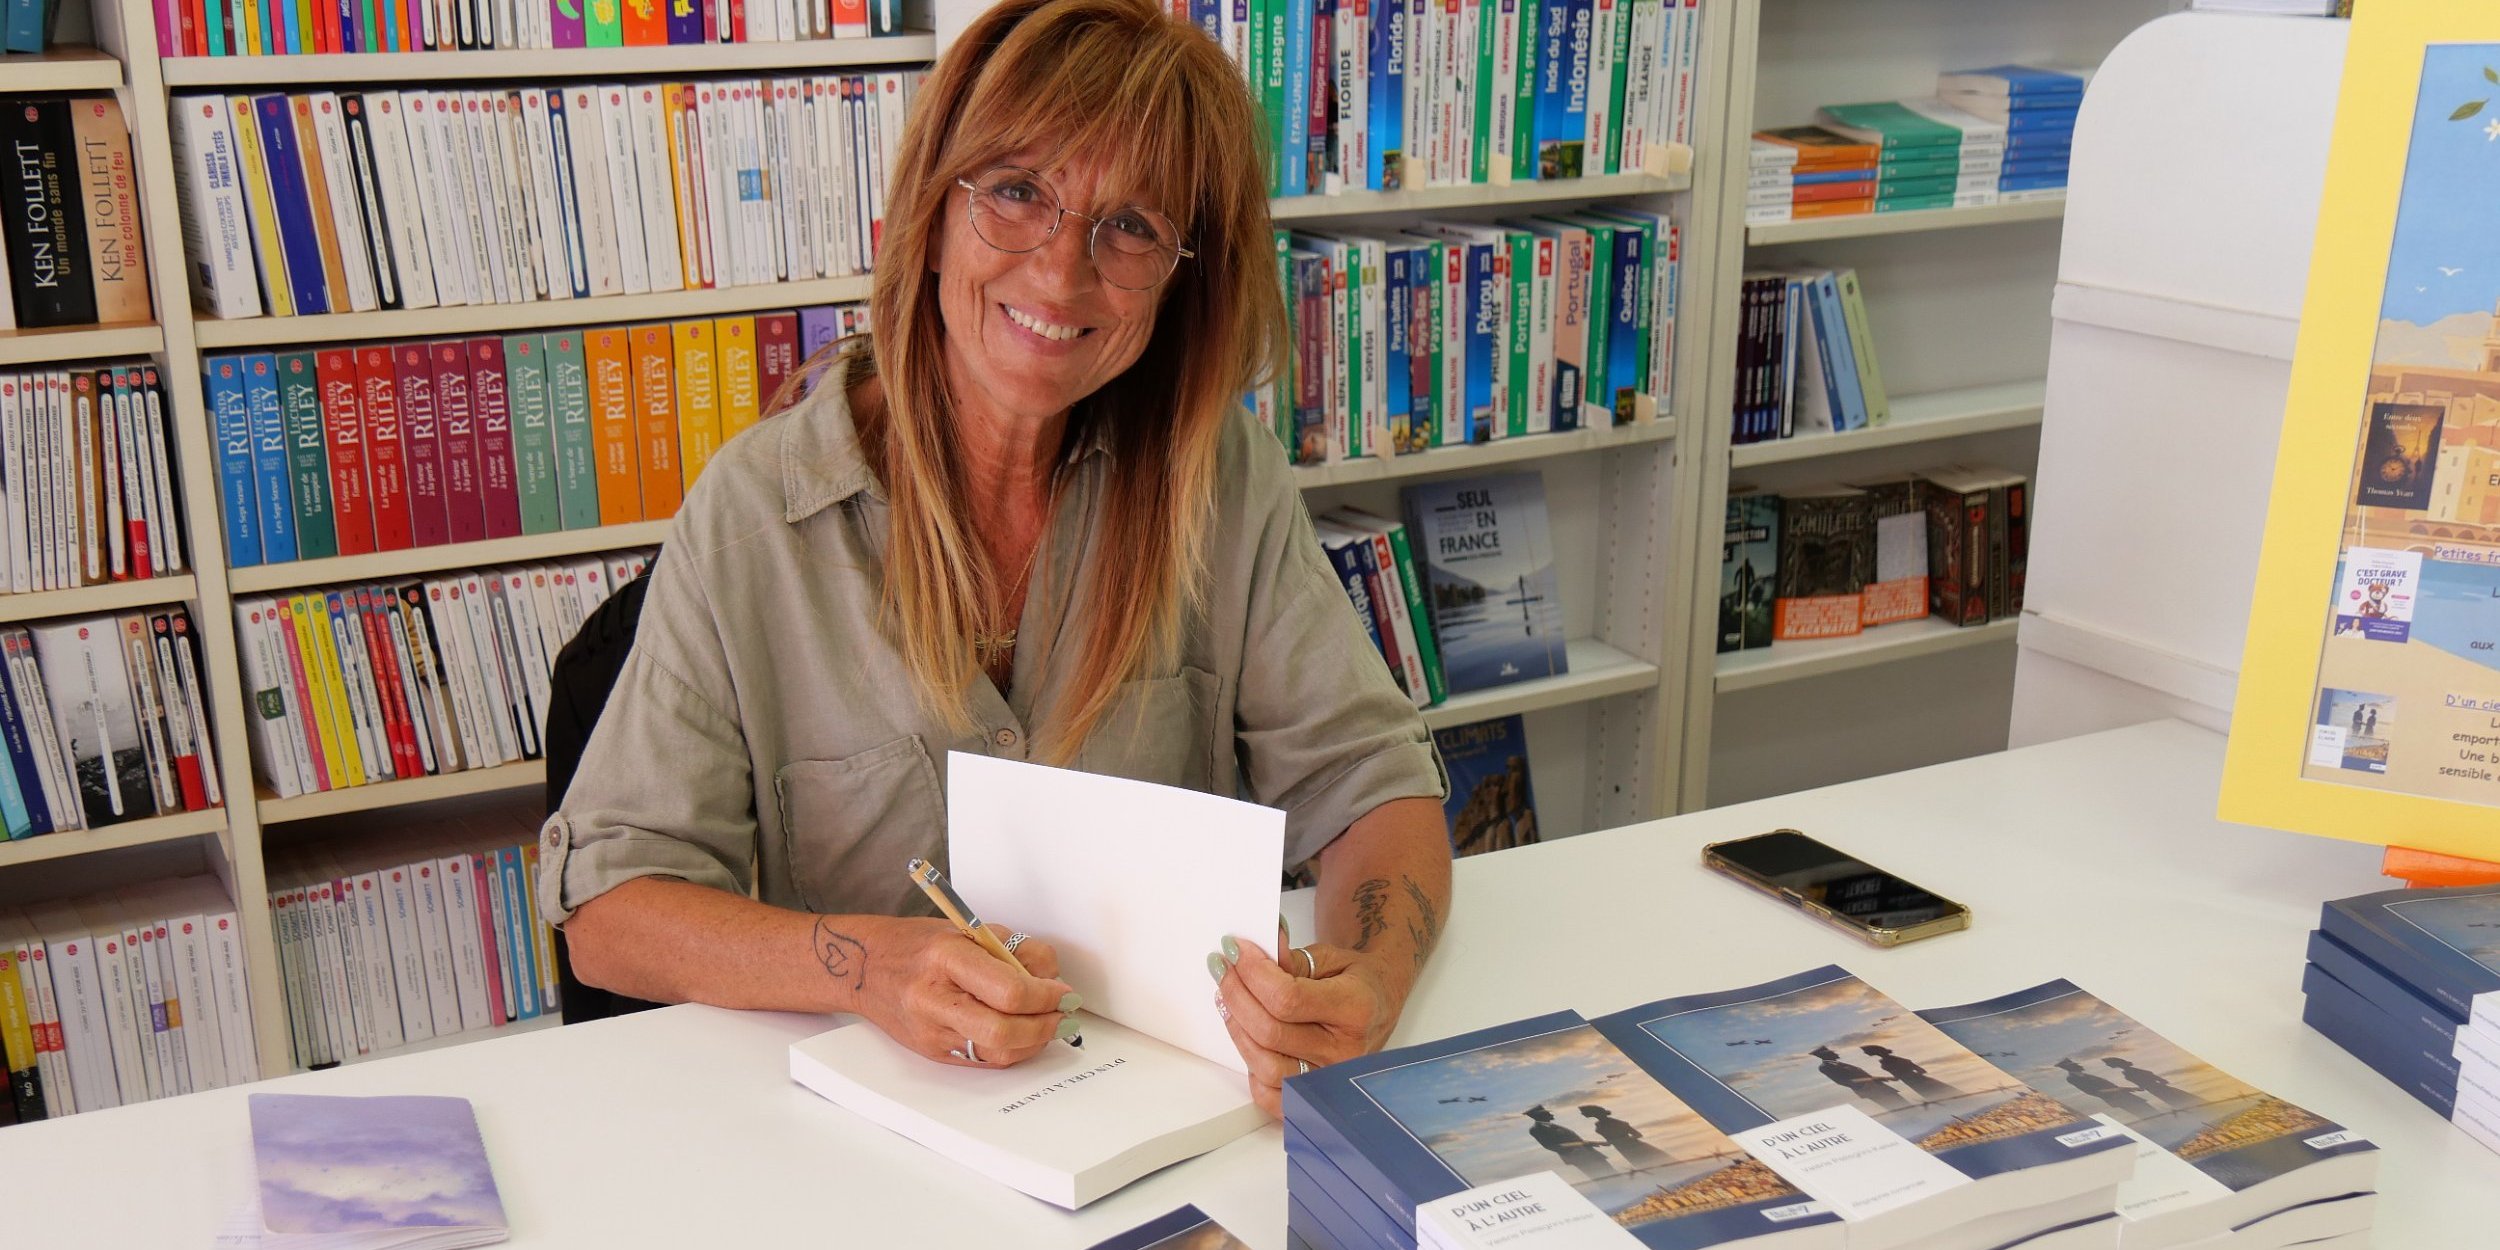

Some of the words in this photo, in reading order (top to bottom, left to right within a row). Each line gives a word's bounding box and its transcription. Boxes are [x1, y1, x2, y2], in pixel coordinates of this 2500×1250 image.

[1255, 11, 1264, 28] Est
[1523, 3, 1537, 69] grecques
[1549, 6, 1562, 36] Sud
[1614, 1, 1628, 63] Irlande
[1269, 14, 1284, 87] Espagne
[1388, 12, 1404, 75] Floride
[1547, 39, 1560, 58] du
[1567, 8, 1590, 113] Indonésie
[1340, 49, 1351, 119] FLORIDE
[1545, 61, 1557, 93] Inde
[1639, 45, 1652, 102] ISLANDE
[43, 152, 56, 168] fin
[112, 152, 124, 171] feu
[213, 131, 226, 154] ESTÉS
[16, 140, 49, 233] FOLLETT
[46, 174, 62, 204] sans
[85, 136, 115, 228] FOLLETT
[114, 175, 127, 189] de
[205, 152, 220, 189] CLARISSA
[215, 156, 232, 187] PINKOLA
[51, 210, 67, 252] monde
[117, 194, 133, 240] colonne
[33, 243, 58, 287] KEN
[57, 258, 70, 275] Un
[100, 239, 124, 281] KEN
[122, 245, 137, 267] Une
[1566, 240, 1584, 326] Portugal
[1620, 264, 1634, 322] Québec
[1415, 290, 1428, 357] Pays-Bas
[1430, 280, 1441, 353] Pays-Bas
[1476, 279, 1493, 334] Pérou
[1515, 282, 1530, 353] Portugal
[1337, 313, 1346, 365] BHOUTAN
[1363, 330, 1374, 382] NORVÈGE
[1391, 321, 1404, 351] Pays
[1491, 301, 1502, 384] PHILIPPINES
[515, 366, 528, 414] LUCINDA
[557, 363, 569, 411] LUCINDA
[597, 359, 609, 407] LUCINDA
[605, 358, 627, 420] RILEY
[641, 355, 653, 402] LUCINDA
[650, 355, 670, 415] RILEY
[685, 350, 696, 396] LUCINDA
[693, 349, 712, 409] RILEY
[726, 348, 737, 394] LUCINDA
[734, 347, 753, 408] RILEY
[250, 388, 265, 437] LUCINDA
[287, 384, 301, 434] LUCINDA
[327, 381, 341, 431] LUCINDA
[336, 380, 359, 444] RILEY
[365, 378, 379, 427] LUCINDA
[375, 376, 397, 440] RILEY
[403, 376, 417, 426] LUCINDA
[413, 374, 435, 439] RILEY
[440, 373, 453, 422] LUCINDA
[449, 371, 471, 435] RILEY
[476, 369, 489, 418] LUCINDA
[485, 368, 507, 432] RILEY
[524, 365, 545, 428] RILEY
[565, 361, 585, 424] RILEY
[217, 391, 230, 441] LUCINDA
[227, 389, 250, 455] RILEY
[261, 387, 284, 451] RILEY
[297, 384, 320, 448] RILEY
[301, 473, 309, 483] de
[418, 485, 426, 495] La
[424, 462, 435, 482] perle
[238, 506, 248, 523] Sept
[273, 502, 283, 519] Sept
[305, 508, 313, 516] La
[1456, 489, 1493, 511] SEUL
[1476, 512, 1497, 529] EN
[240, 524, 249, 537] Les
[275, 520, 283, 534] Les
[1439, 530, 1500, 555] FRANCE
[2356, 568, 2379, 578] C'EST
[2380, 569, 2408, 579] GRAVE
[2434, 545, 2482, 561] Petites
[2357, 578, 2396, 586] DOCTEUR
[2470, 640, 2495, 650] aux
[2445, 694, 2477, 707] D'un
[1440, 722, 1508, 749] CLIMATS
[2459, 749, 2485, 762] Une
[2439, 766, 2492, 781] sensible
[347, 897, 359, 927] SCHMITT
[364, 895, 376, 926] SCHMITT
[396, 888, 407, 919] SCHMITT
[424, 883, 435, 913] SCHMITT
[454, 878, 465, 908] SCHMITT
[280, 913, 292, 944] SCHMITT
[299, 909, 310, 939] SCHMITT
[310, 907, 323, 937] SCHMITT
[323, 903, 336, 934] SCHMITT
[1067, 1071, 1096, 1084] CIEL
[1094, 1058, 1126, 1073] D'UN
[1761, 1129, 1799, 1148] D'UN
[1799, 1122, 1837, 1139] CIEL
[1777, 1148, 1794, 1160] À
[1793, 1133, 1855, 1157] L'AUTRE
[1451, 1200, 1491, 1219] D'UN
[1493, 1189, 1534, 1206] CIEL
[1468, 1218, 1483, 1232] À
[1481, 1202, 1547, 1227] L'AUTRE
